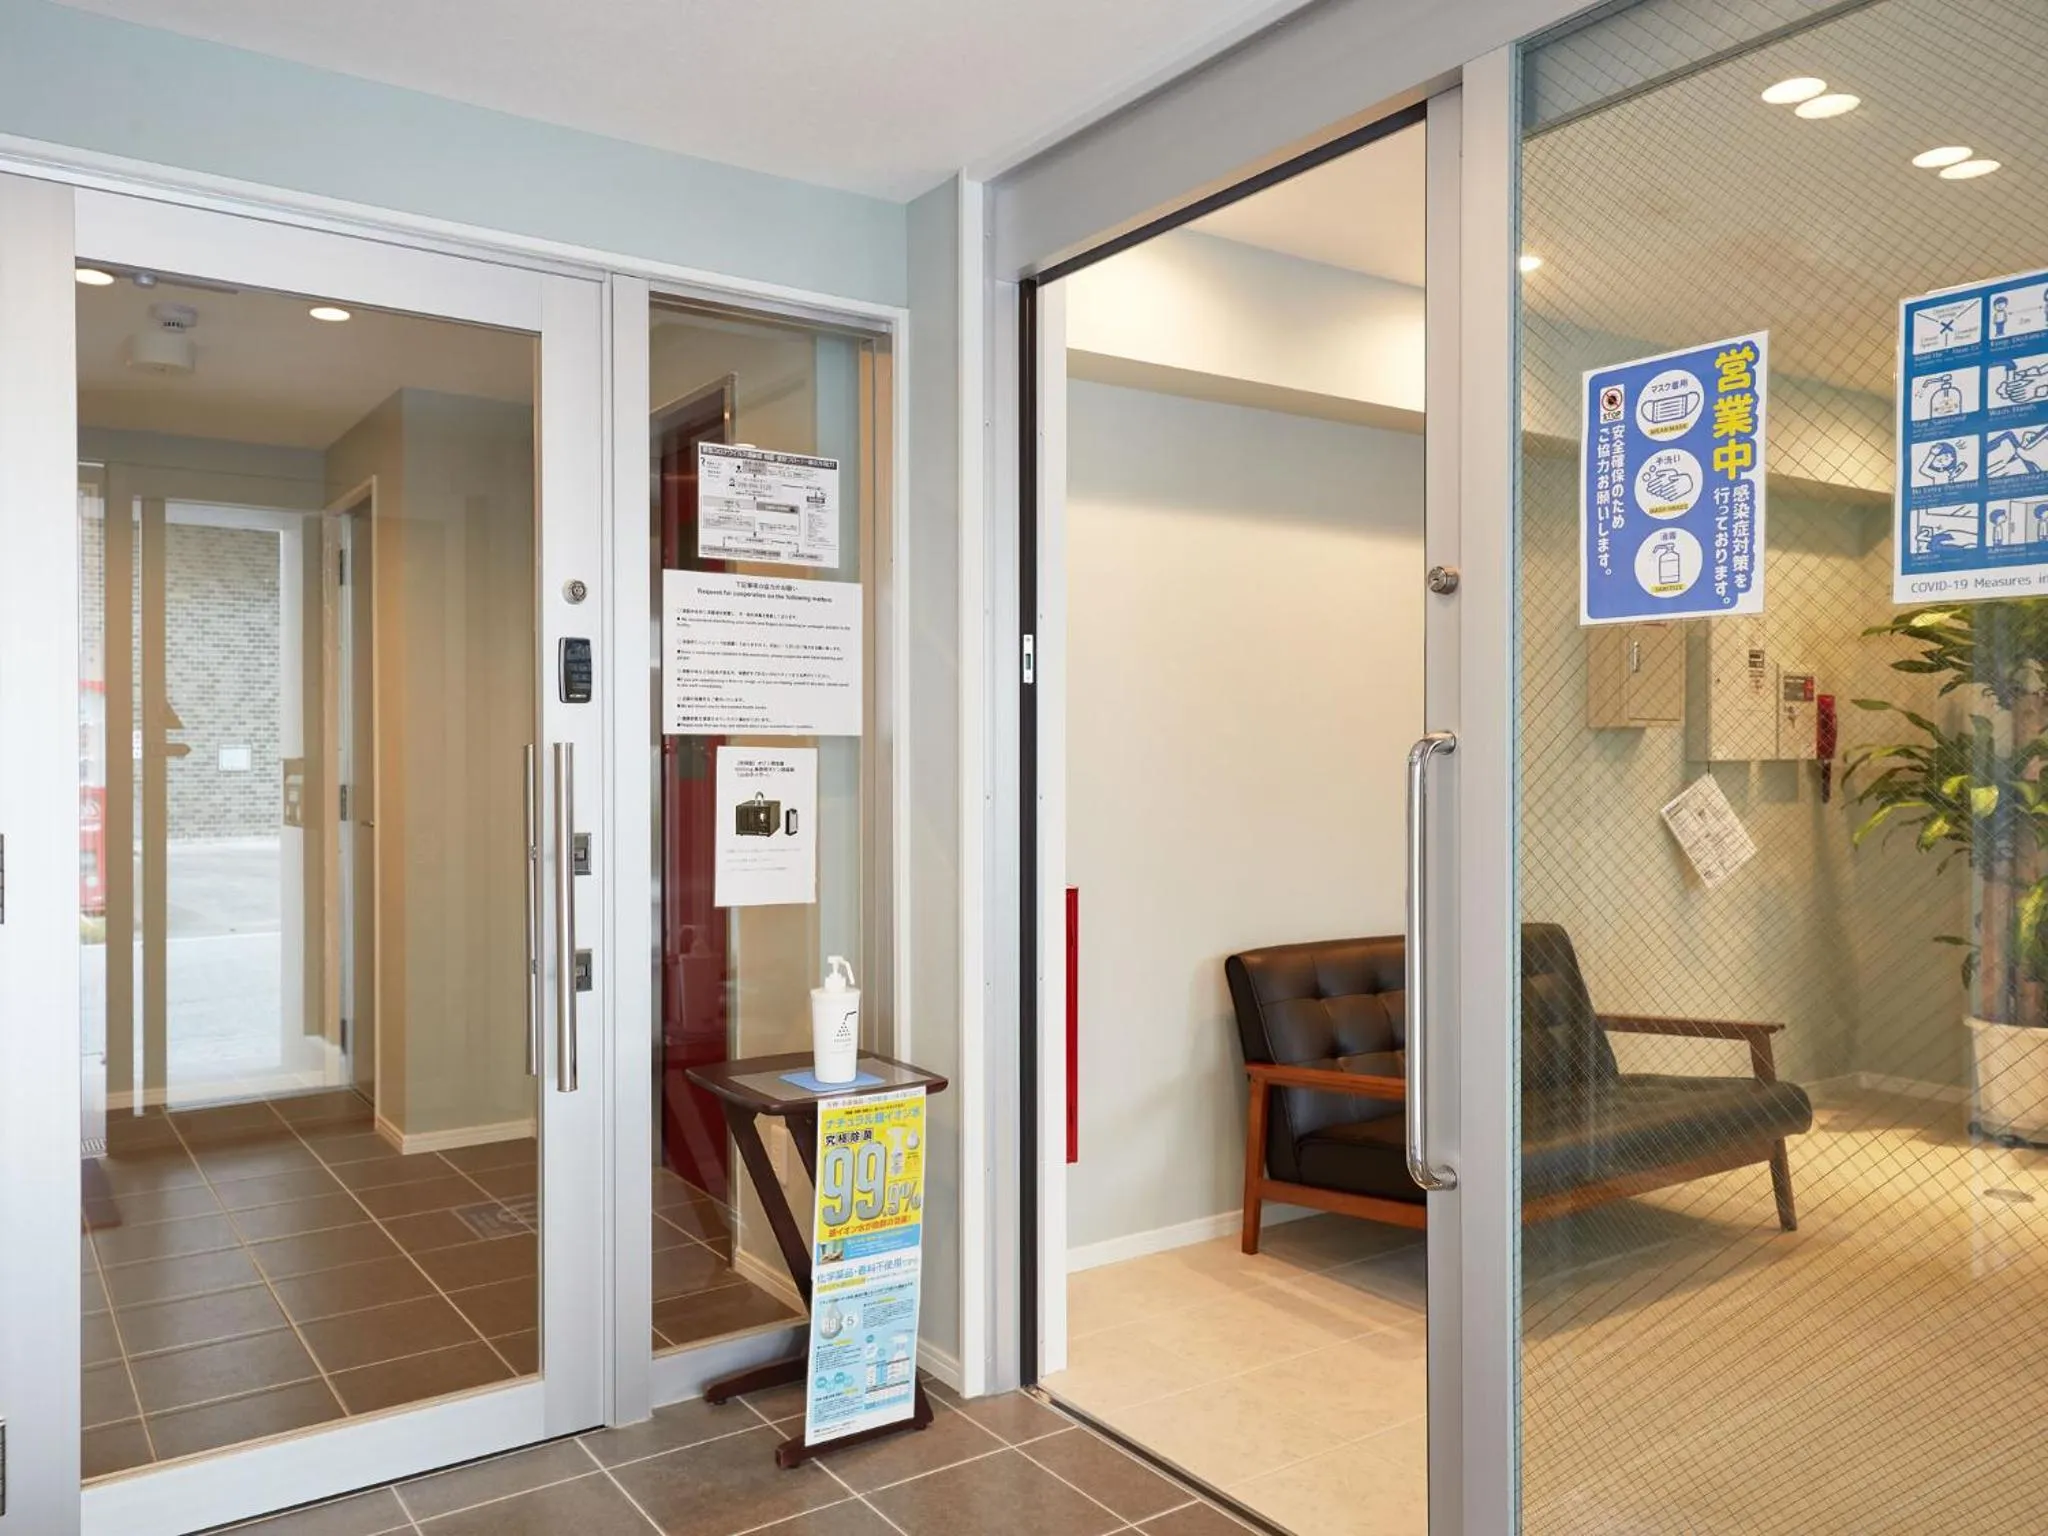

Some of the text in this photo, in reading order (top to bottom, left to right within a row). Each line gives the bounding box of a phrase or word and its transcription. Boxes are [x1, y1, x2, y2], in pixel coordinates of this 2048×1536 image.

[1603, 411, 1621, 421] STOP
[1656, 455, 1681, 465] 手洗い
[1713, 346, 1754, 480] 営業中
[1597, 428, 1612, 576] ご協力お願いします。
[1611, 424, 1626, 529] 安全確保のため
[1713, 487, 1731, 604] 行っております。
[1732, 484, 1750, 588] 感染症対策を
[1910, 579, 1968, 594] COVID-19
[1975, 575, 2033, 589] Measures
